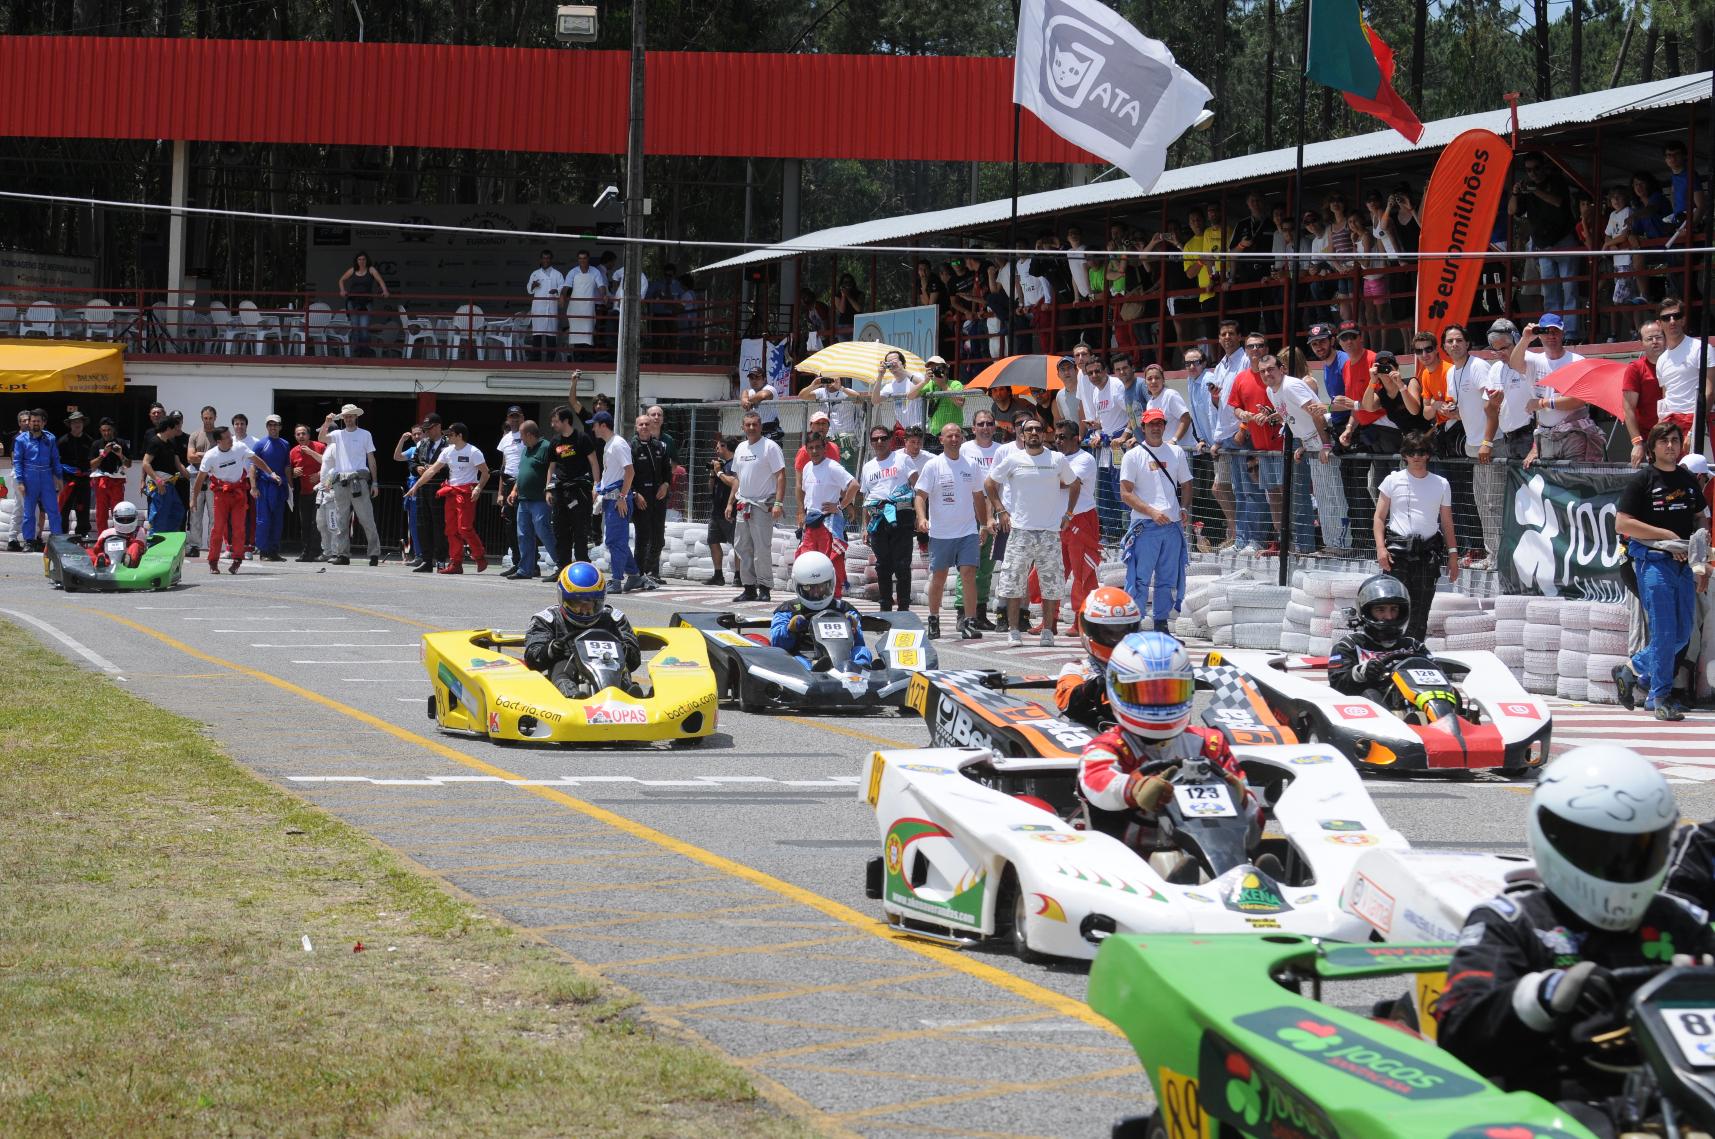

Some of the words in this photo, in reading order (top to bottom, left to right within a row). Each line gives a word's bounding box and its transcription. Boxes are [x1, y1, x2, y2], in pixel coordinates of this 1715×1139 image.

[1437, 148, 1489, 297] euromilhões
[869, 467, 898, 482] UNITRIP
[589, 641, 613, 650] 93
[911, 681, 926, 711] 127
[1186, 787, 1219, 799] 123
[1324, 1045, 1445, 1090] JOGOS
